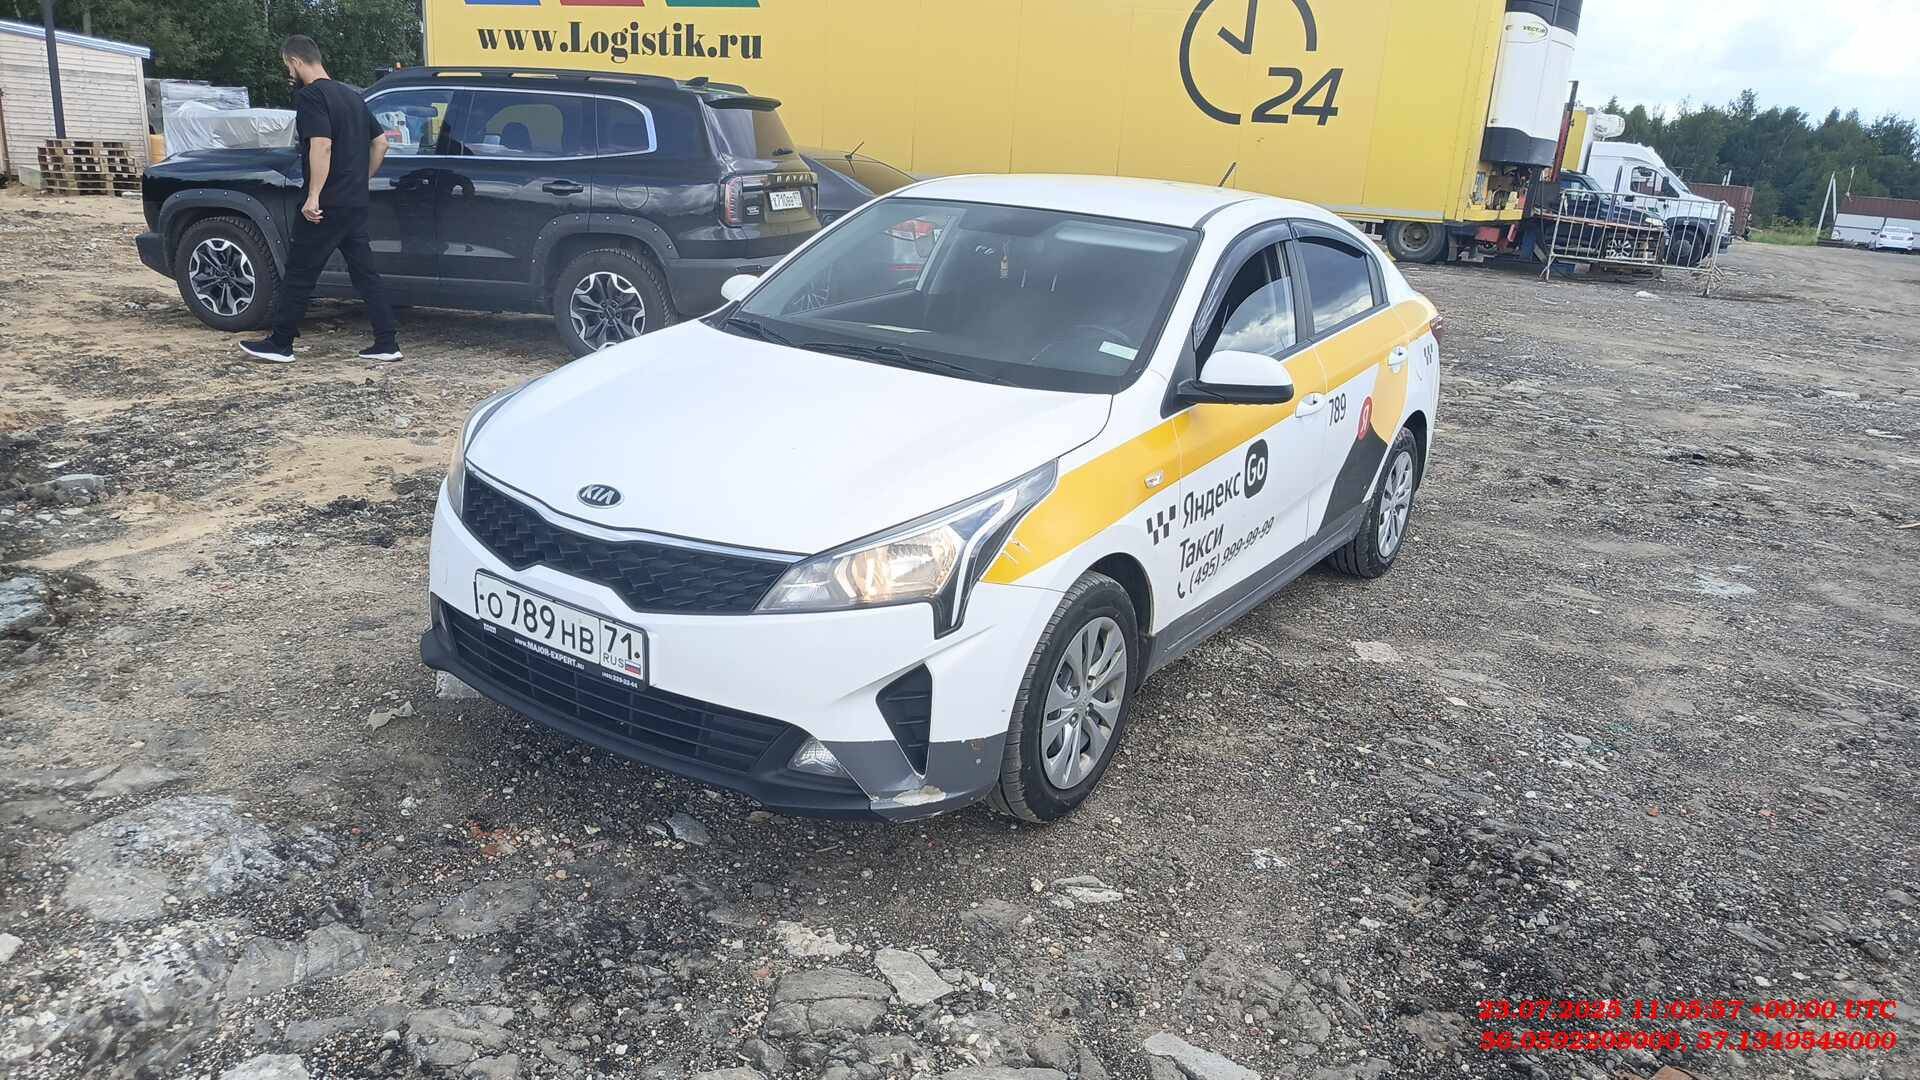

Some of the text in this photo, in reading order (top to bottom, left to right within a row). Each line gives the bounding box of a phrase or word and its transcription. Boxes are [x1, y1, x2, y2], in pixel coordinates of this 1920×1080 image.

[477, 21, 762, 63] www.Logistik.ru
[1251, 67, 1344, 126] 24
[1329, 393, 1347, 426] 789
[581, 485, 615, 505] KIA
[1183, 453, 1266, 529] Яндекс Go
[1180, 523, 1224, 573] Такси
[1189, 516, 1275, 594] (495) 999-99-99
[602, 653, 624, 669] RUS
[604, 625, 632, 660] 71
